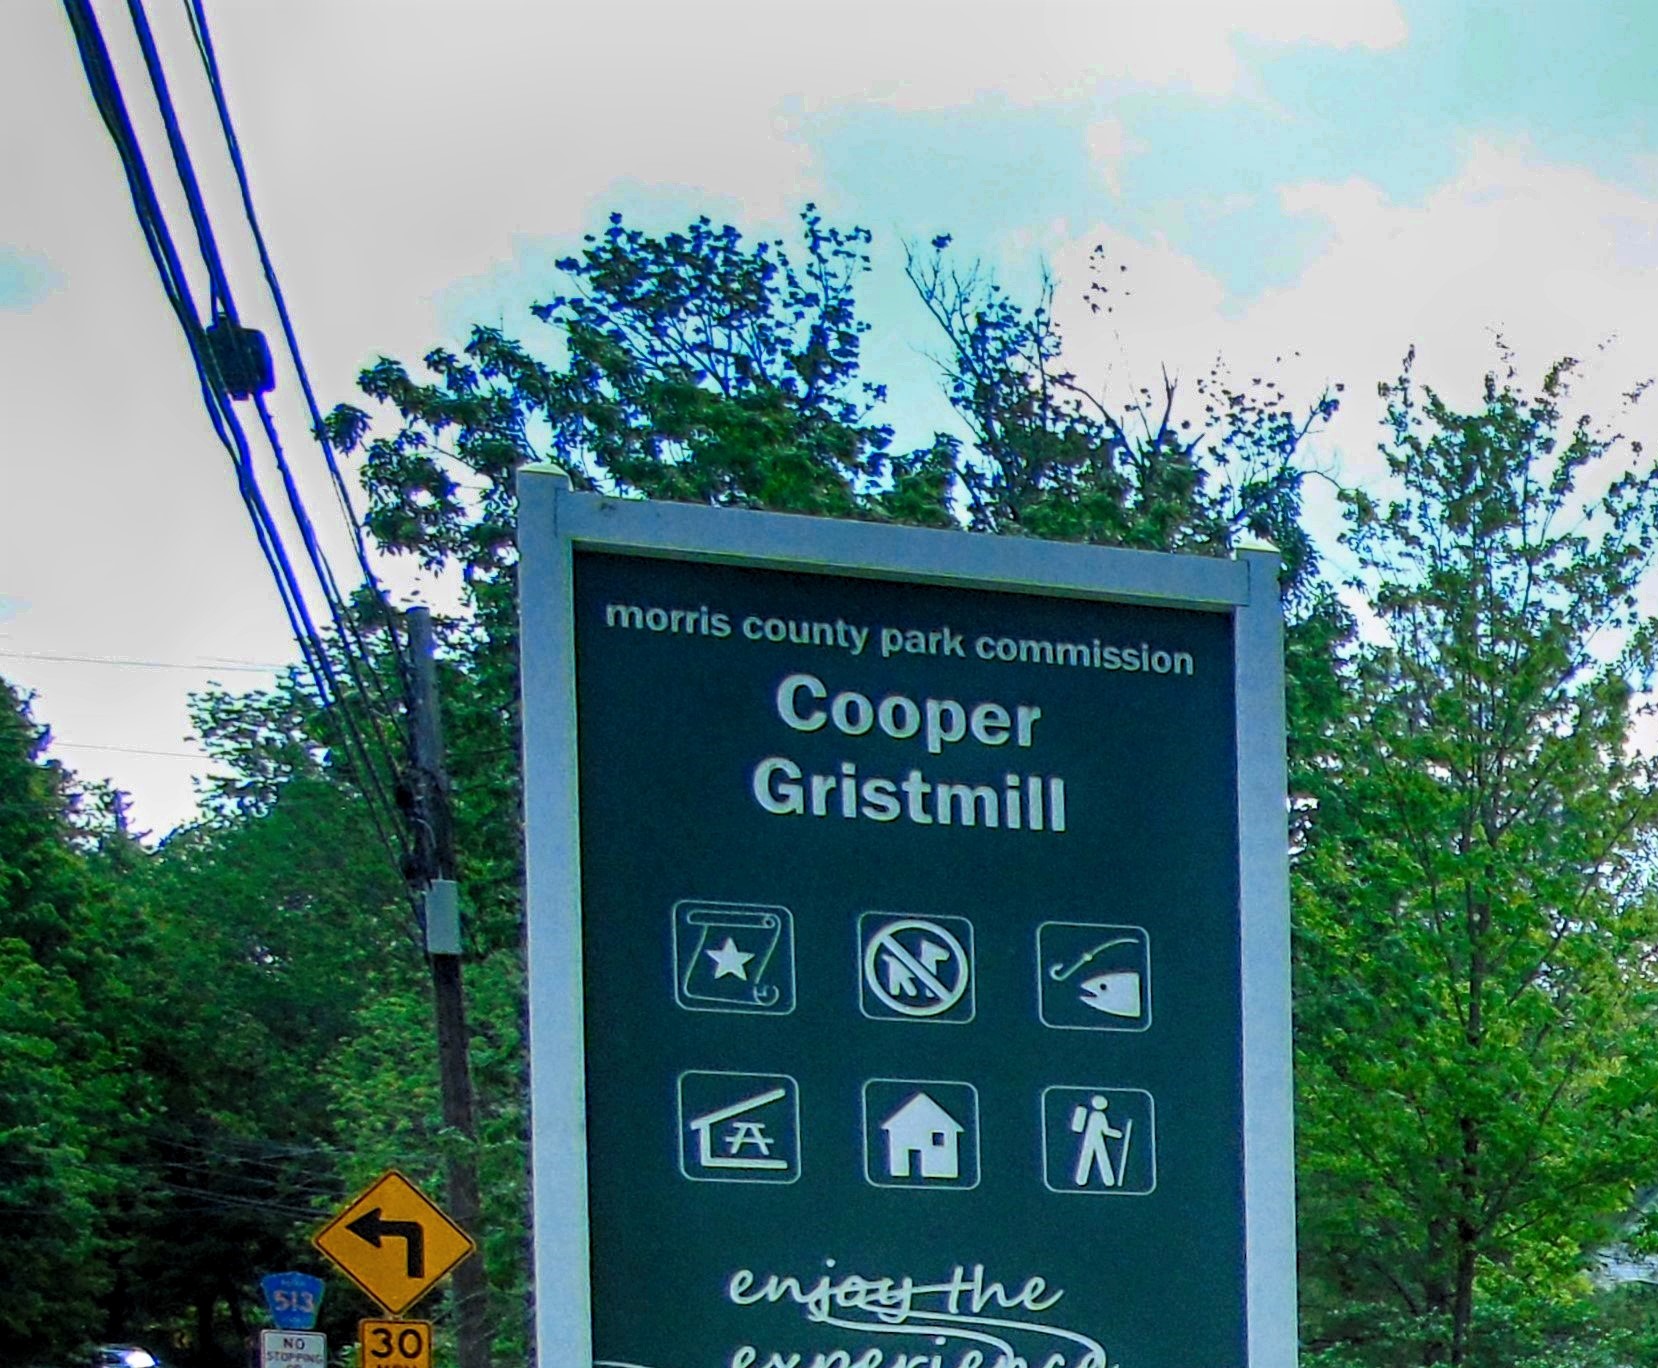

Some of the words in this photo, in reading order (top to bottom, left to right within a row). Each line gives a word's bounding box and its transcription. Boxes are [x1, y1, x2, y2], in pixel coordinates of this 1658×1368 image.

[605, 603, 731, 637] morris
[742, 616, 868, 655] county
[881, 626, 967, 657] park
[976, 635, 1194, 675] commission
[777, 673, 1041, 754] Cooper
[753, 757, 1066, 832] Gristmill
[273, 1289, 314, 1313] 513
[729, 1258, 912, 1324] enjoy
[942, 1264, 1064, 1312] the
[266, 1351, 323, 1364] STOPPING
[283, 1338, 305, 1350] NO
[371, 1328, 422, 1359] 30
